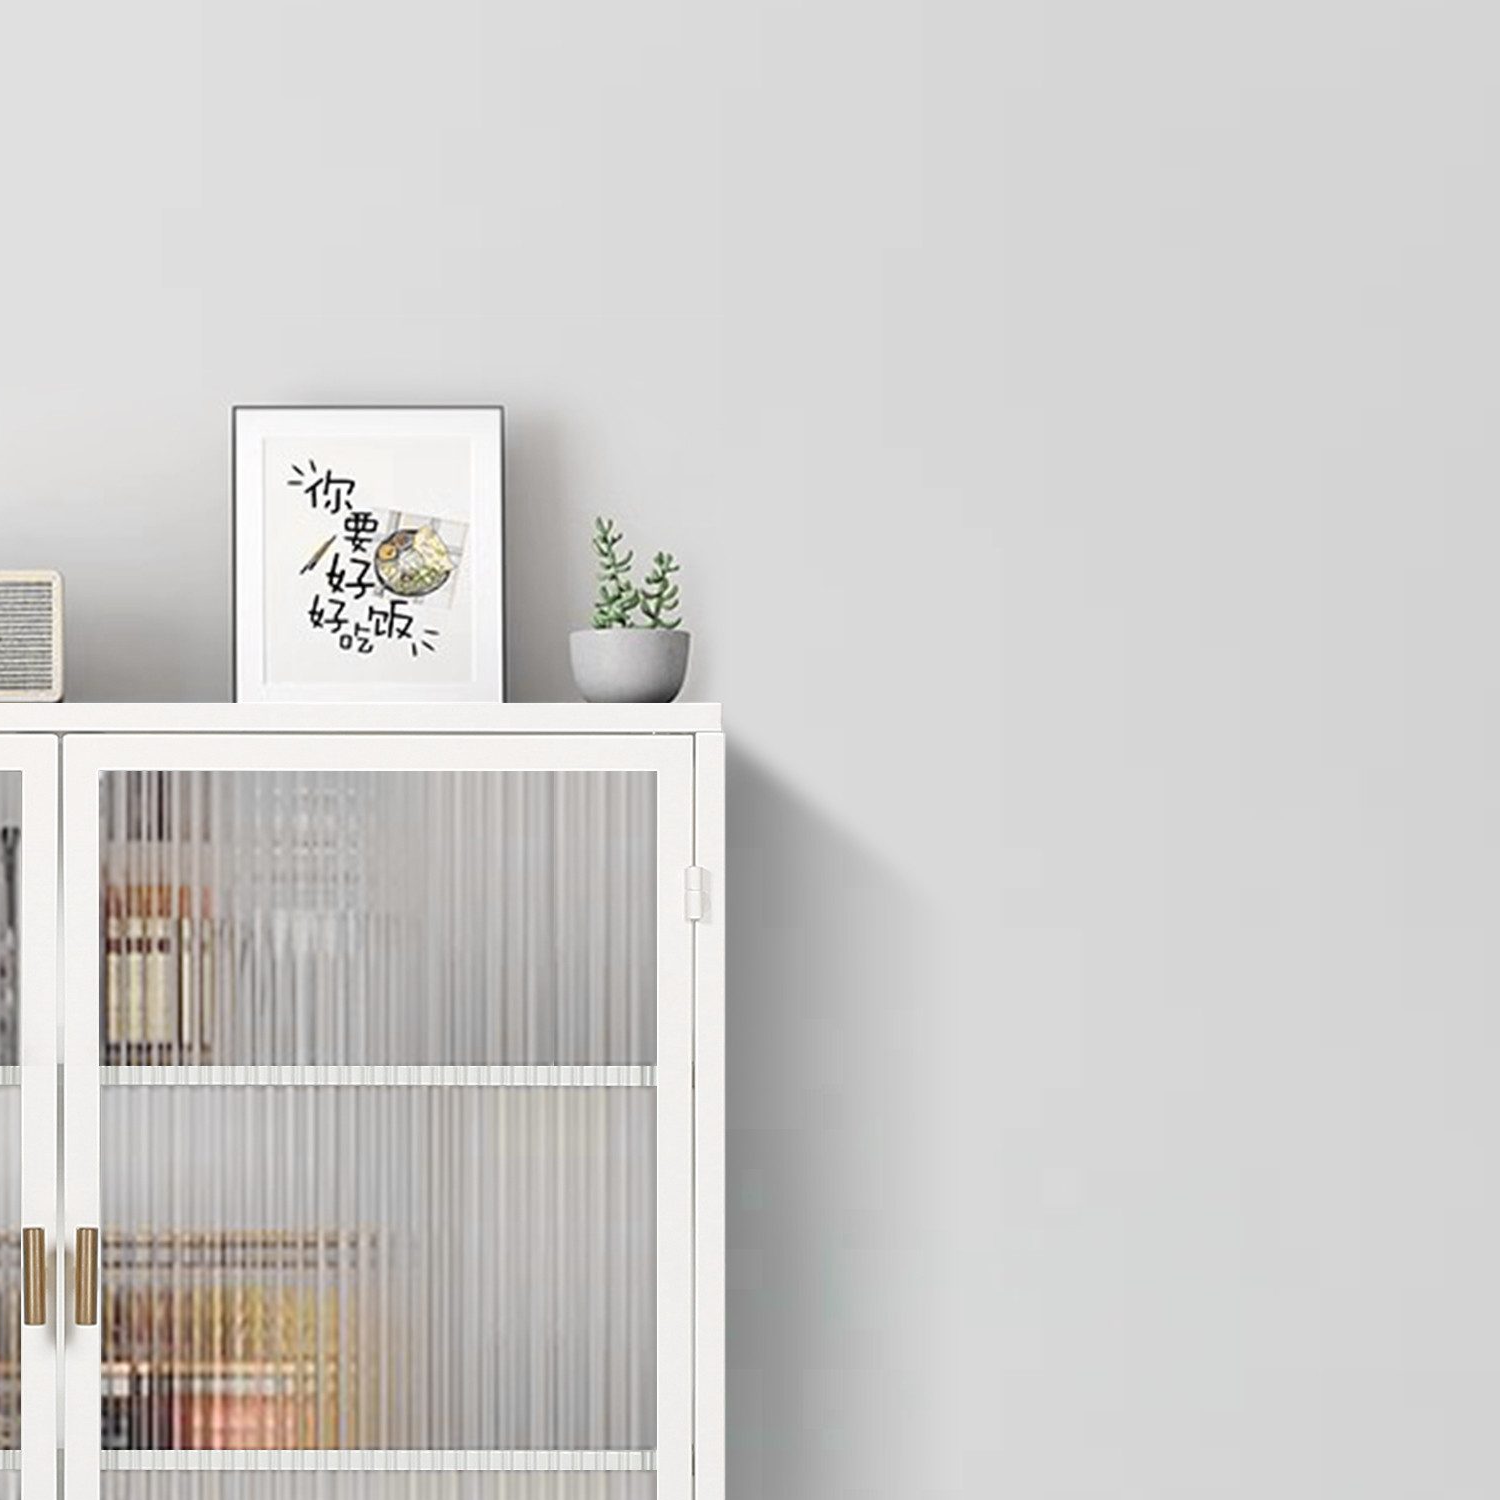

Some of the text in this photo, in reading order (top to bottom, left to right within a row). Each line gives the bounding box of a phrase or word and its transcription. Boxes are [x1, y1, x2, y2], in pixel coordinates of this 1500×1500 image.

[303, 469, 356, 514] 你
[344, 511, 379, 553] 要
[326, 553, 376, 599] 好
